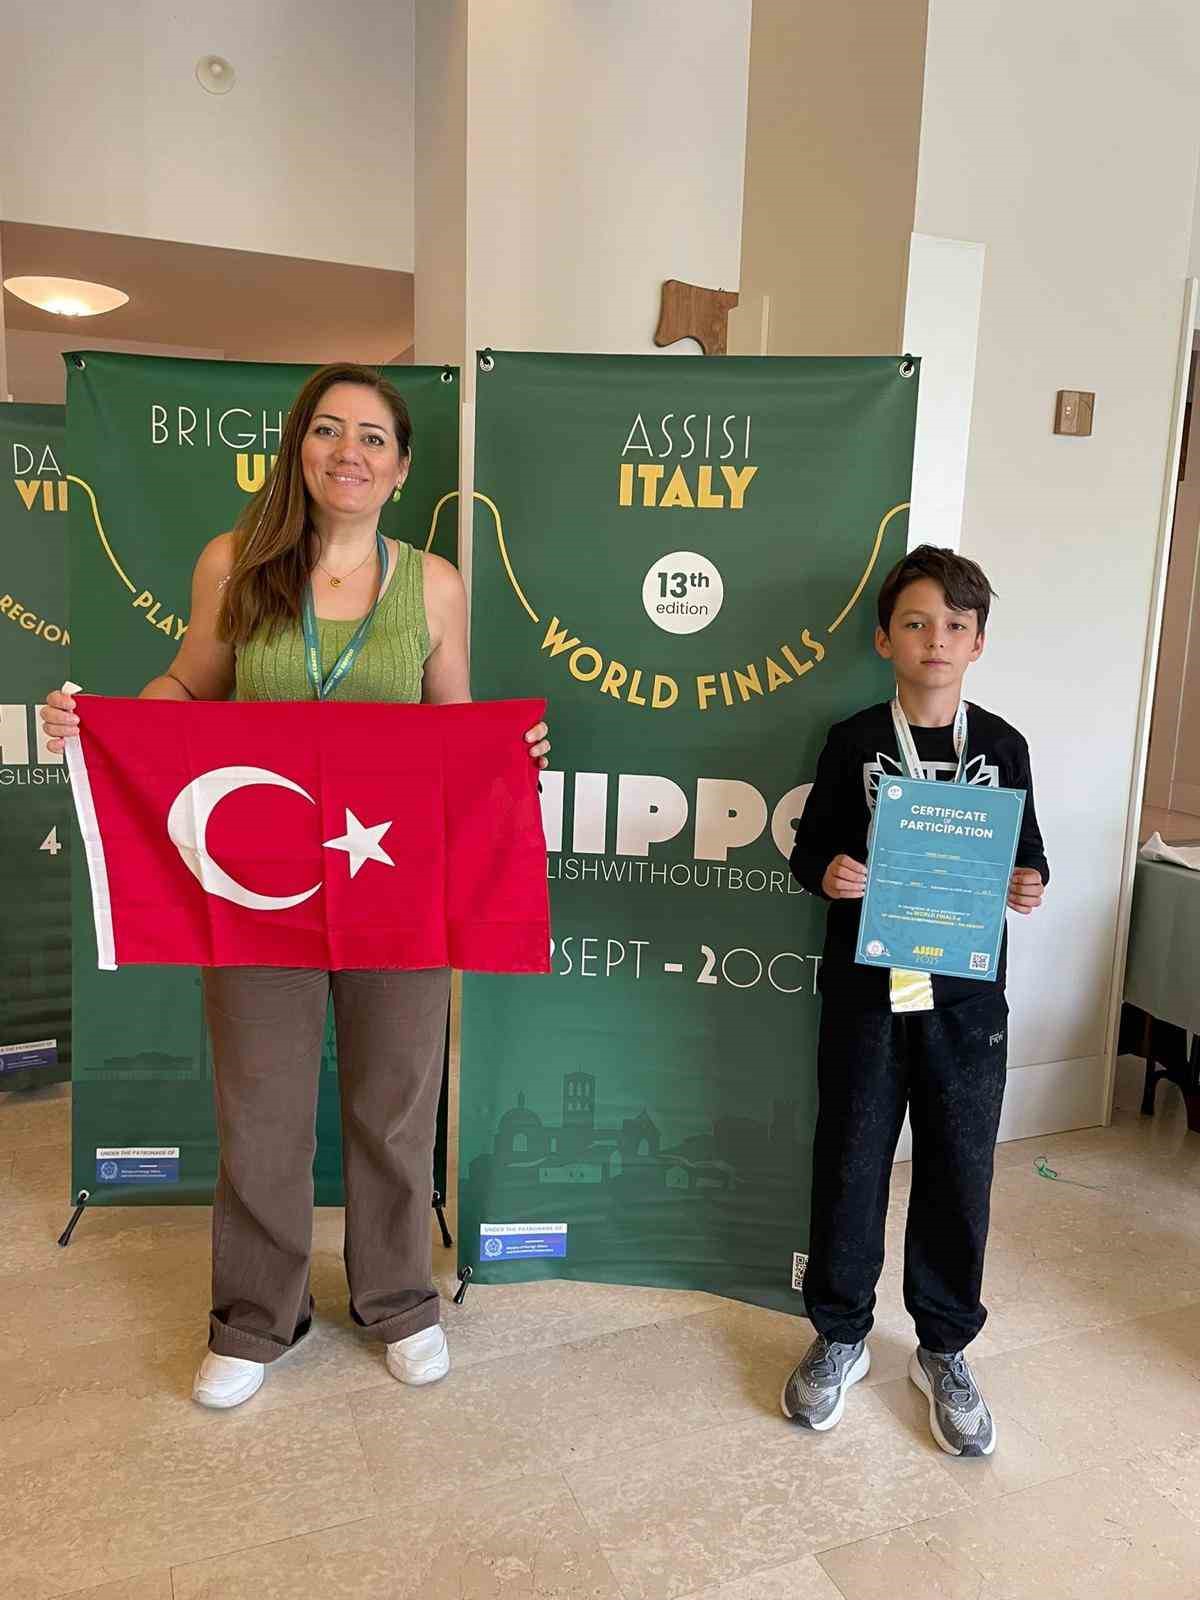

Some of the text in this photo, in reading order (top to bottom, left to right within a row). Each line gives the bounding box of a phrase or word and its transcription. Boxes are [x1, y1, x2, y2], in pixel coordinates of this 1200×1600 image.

[150, 405, 291, 449] BRIGH
[621, 413, 752, 459] ASSISI
[236, 453, 278, 492] U
[619, 463, 759, 509] ITALY
[657, 572, 710, 598] 13th
[132, 590, 188, 641] PLAY
[656, 601, 708, 615] edition
[541, 616, 825, 710] WORLD FINALS
[900, 819, 993, 839] PARTICIPATION
[911, 805, 988, 822] CERTIFICATE
[39, 825, 62, 855] 4
[550, 936, 650, 978] SEPT
